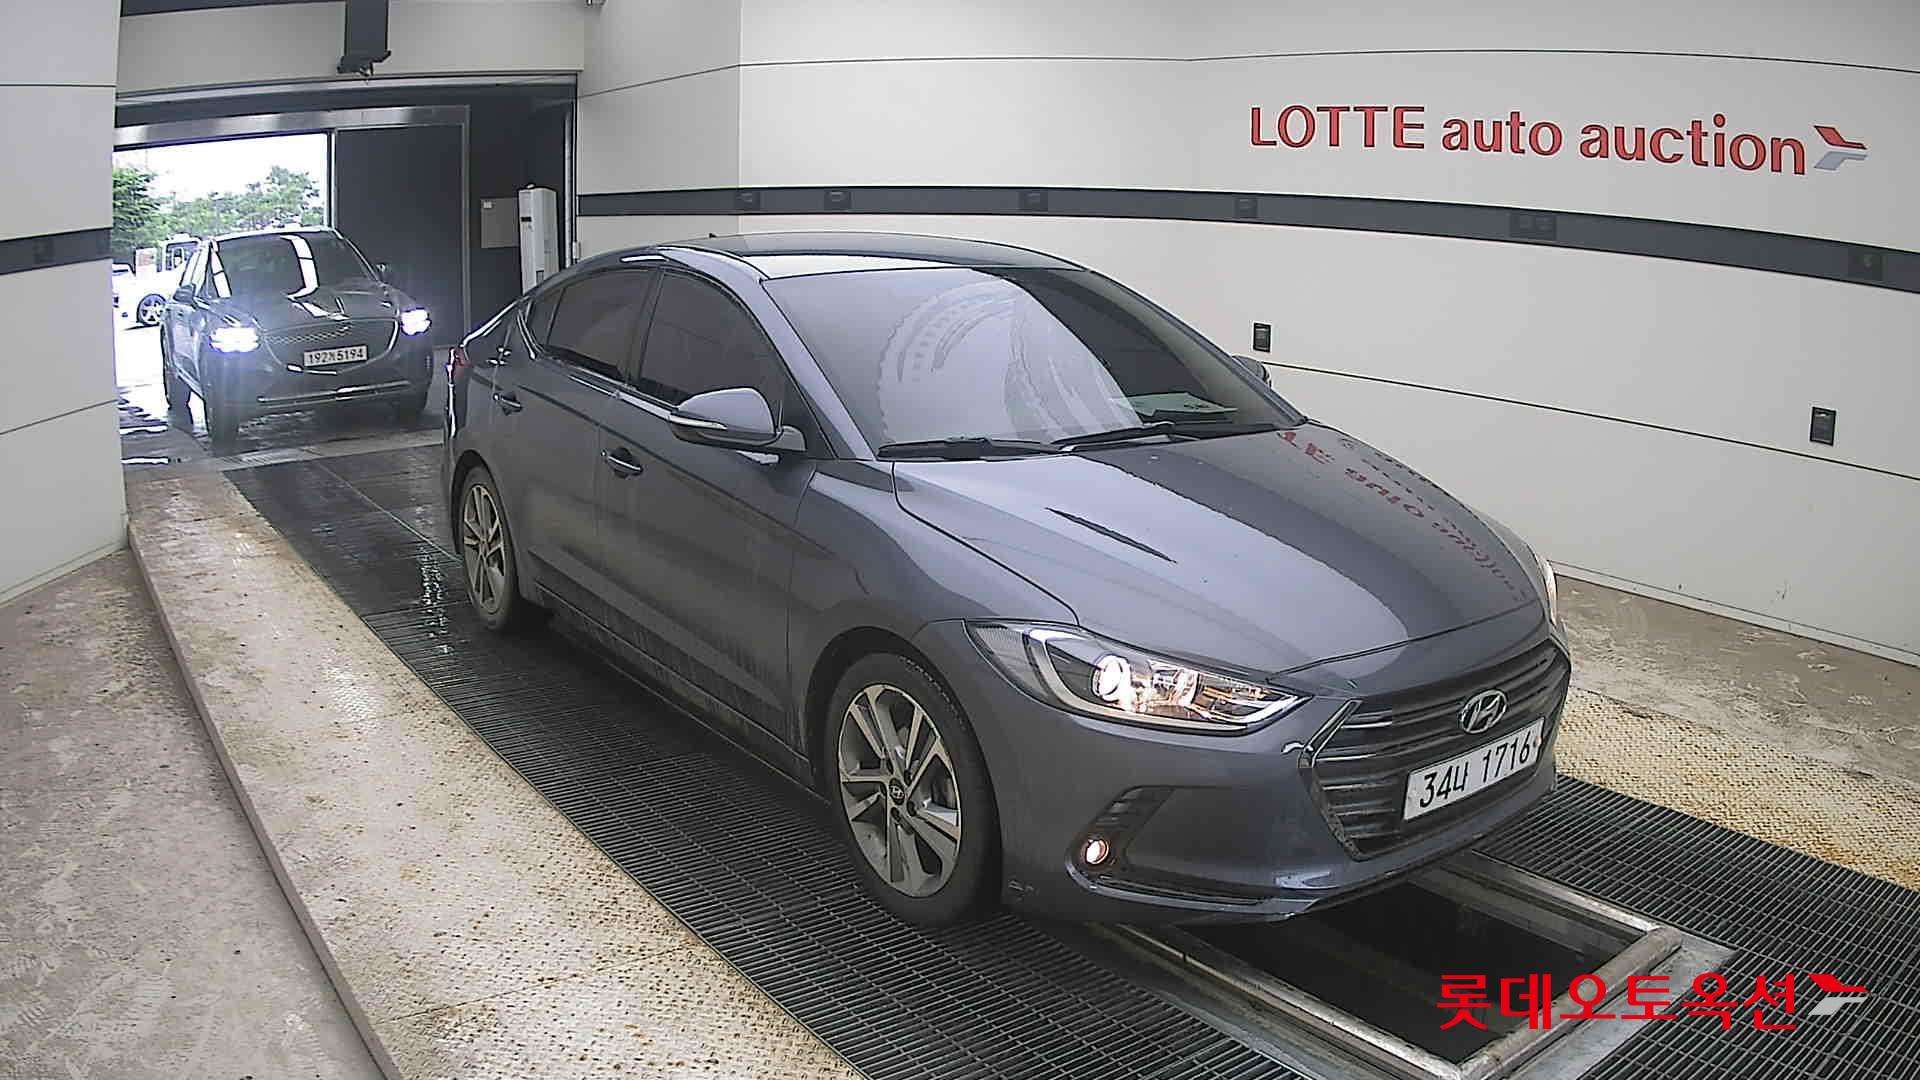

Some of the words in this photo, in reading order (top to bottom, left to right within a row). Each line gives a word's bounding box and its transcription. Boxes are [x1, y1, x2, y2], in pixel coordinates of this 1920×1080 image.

[1250, 104, 1425, 150] LOTTE
[1441, 111, 1564, 157] auto
[1578, 114, 1807, 175] auction
[1482, 730, 1532, 782] 1716
